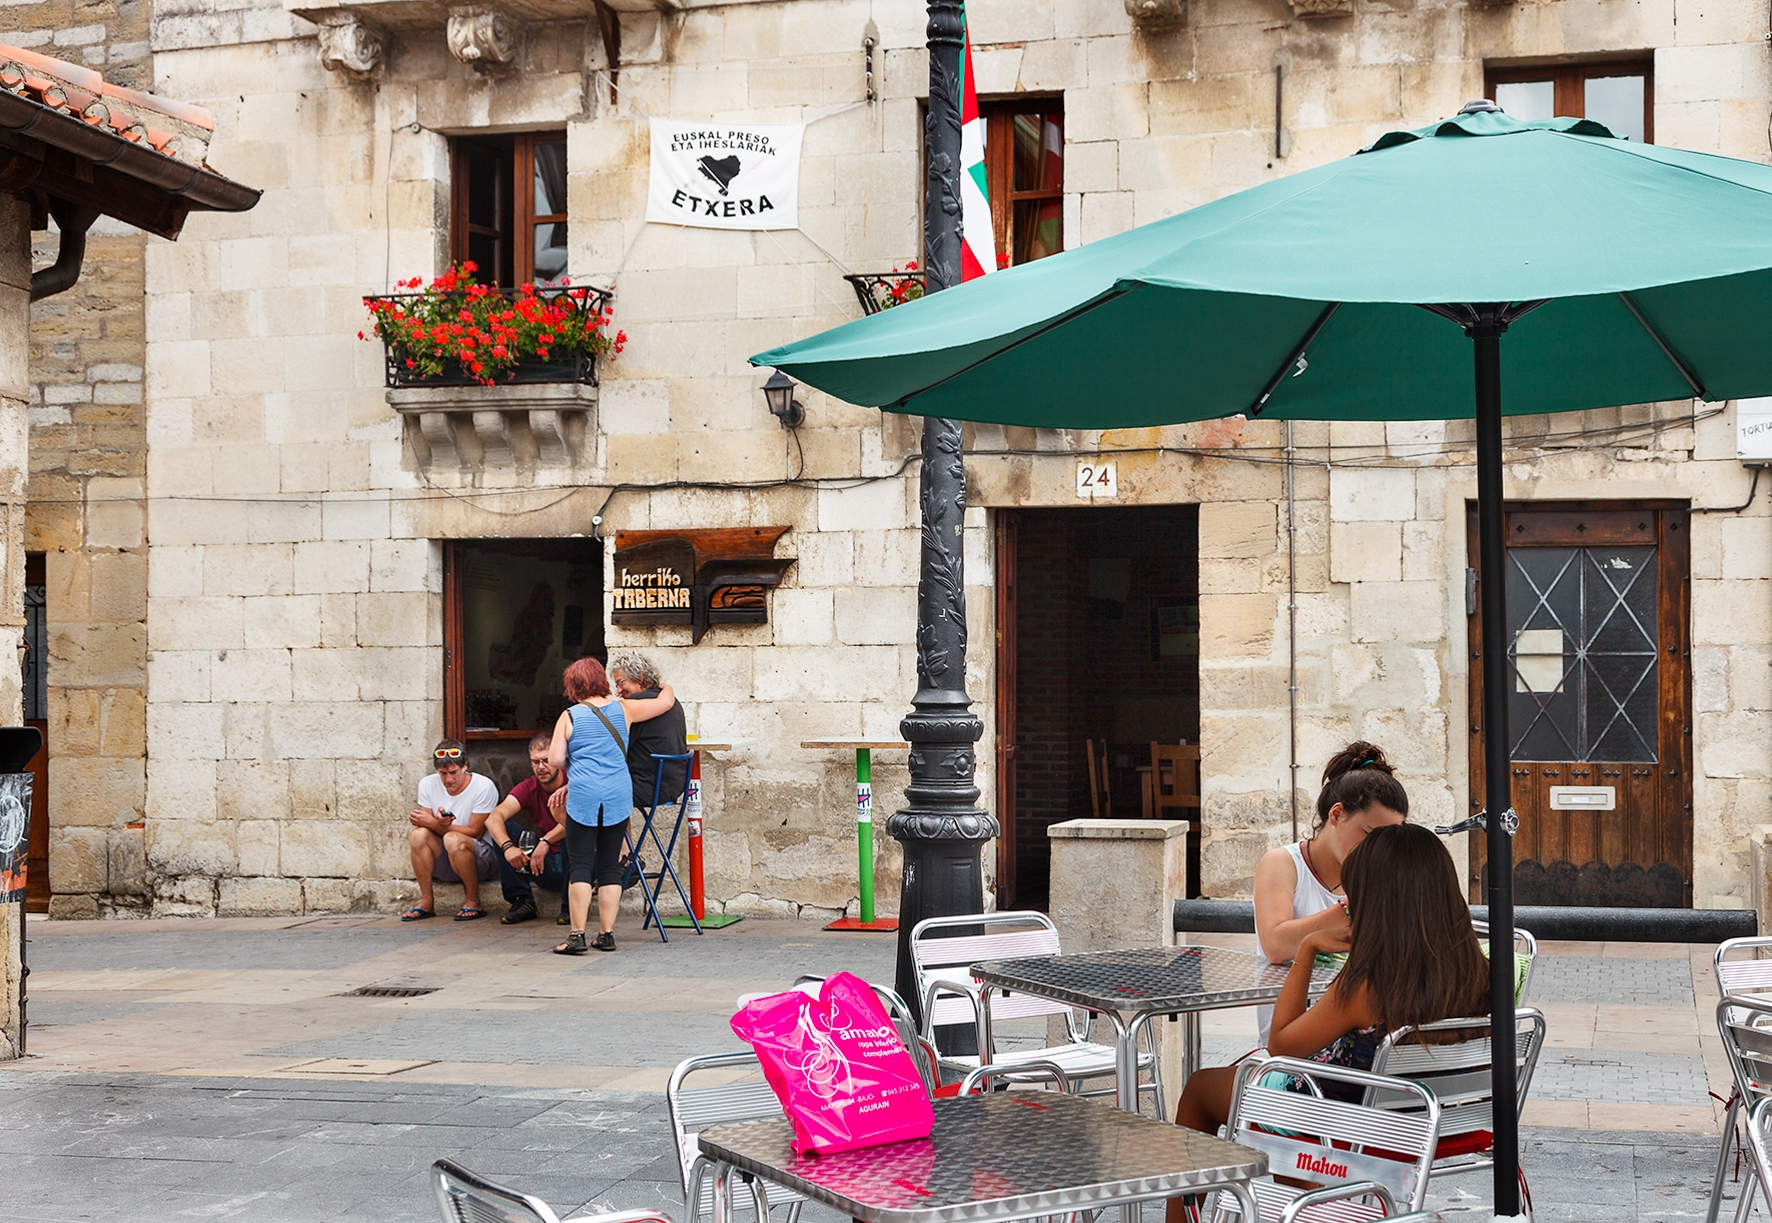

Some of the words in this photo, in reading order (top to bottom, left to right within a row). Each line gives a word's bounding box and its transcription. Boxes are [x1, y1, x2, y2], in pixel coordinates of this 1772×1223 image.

[673, 131, 723, 142] EUSKAL
[728, 131, 770, 145] PRESO
[671, 142, 694, 152] ETA
[699, 140, 777, 156] IHESLARIAK
[671, 189, 775, 218] ETXERA
[1081, 467, 1110, 487] 24
[613, 587, 691, 609] TABERNA
[858, 1041, 874, 1049] ropa
[858, 1100, 890, 1115] AGURAIN
[1295, 1152, 1348, 1179] Mahou
